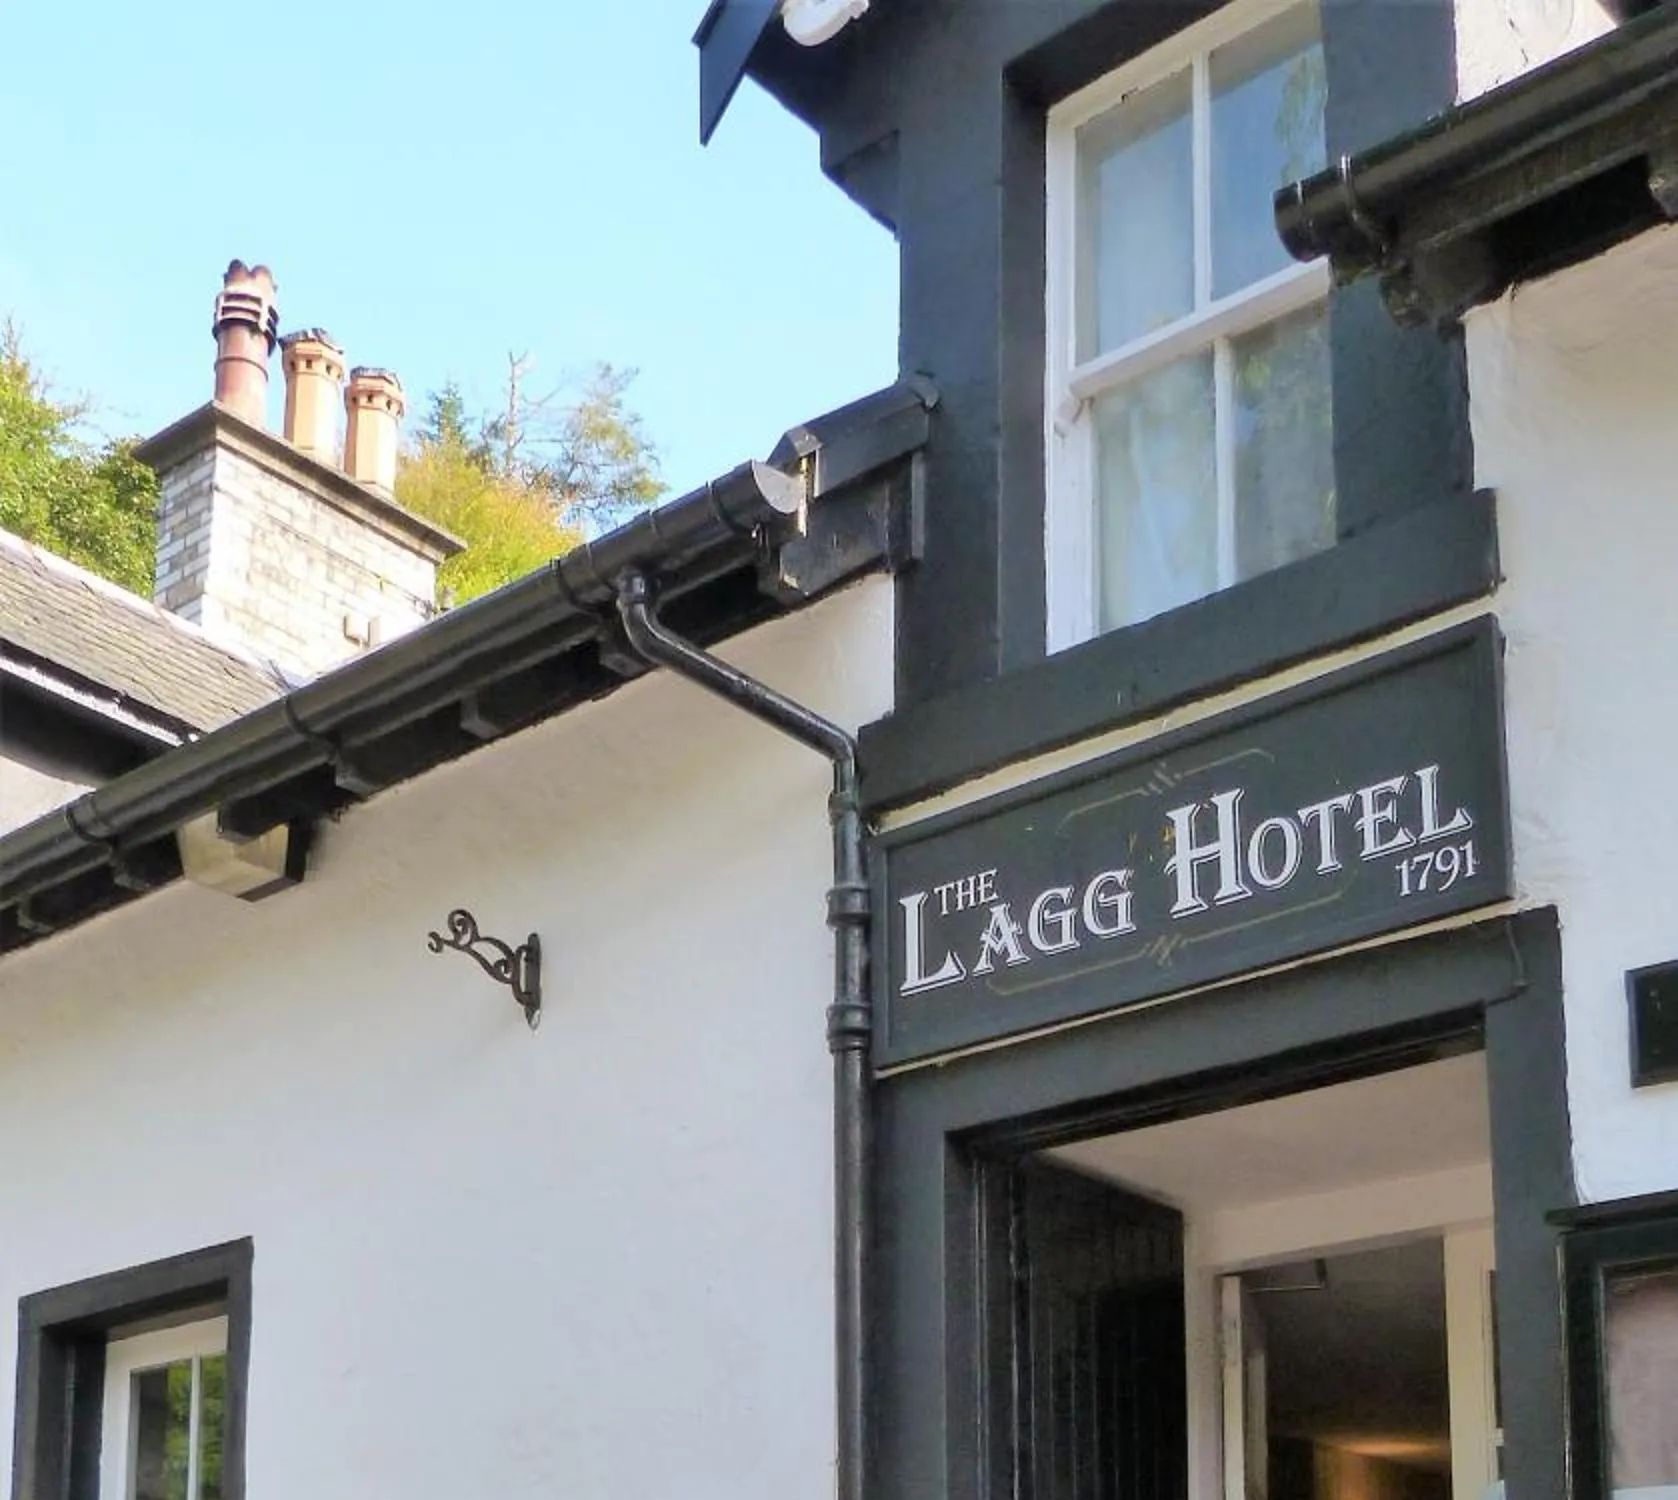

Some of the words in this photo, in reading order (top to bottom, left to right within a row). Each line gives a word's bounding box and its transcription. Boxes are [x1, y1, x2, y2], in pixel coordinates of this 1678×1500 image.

[900, 869, 1137, 996] LAGG
[1165, 765, 1473, 919] HOTEL
[934, 869, 998, 916] THE
[1396, 840, 1480, 897] 1791
